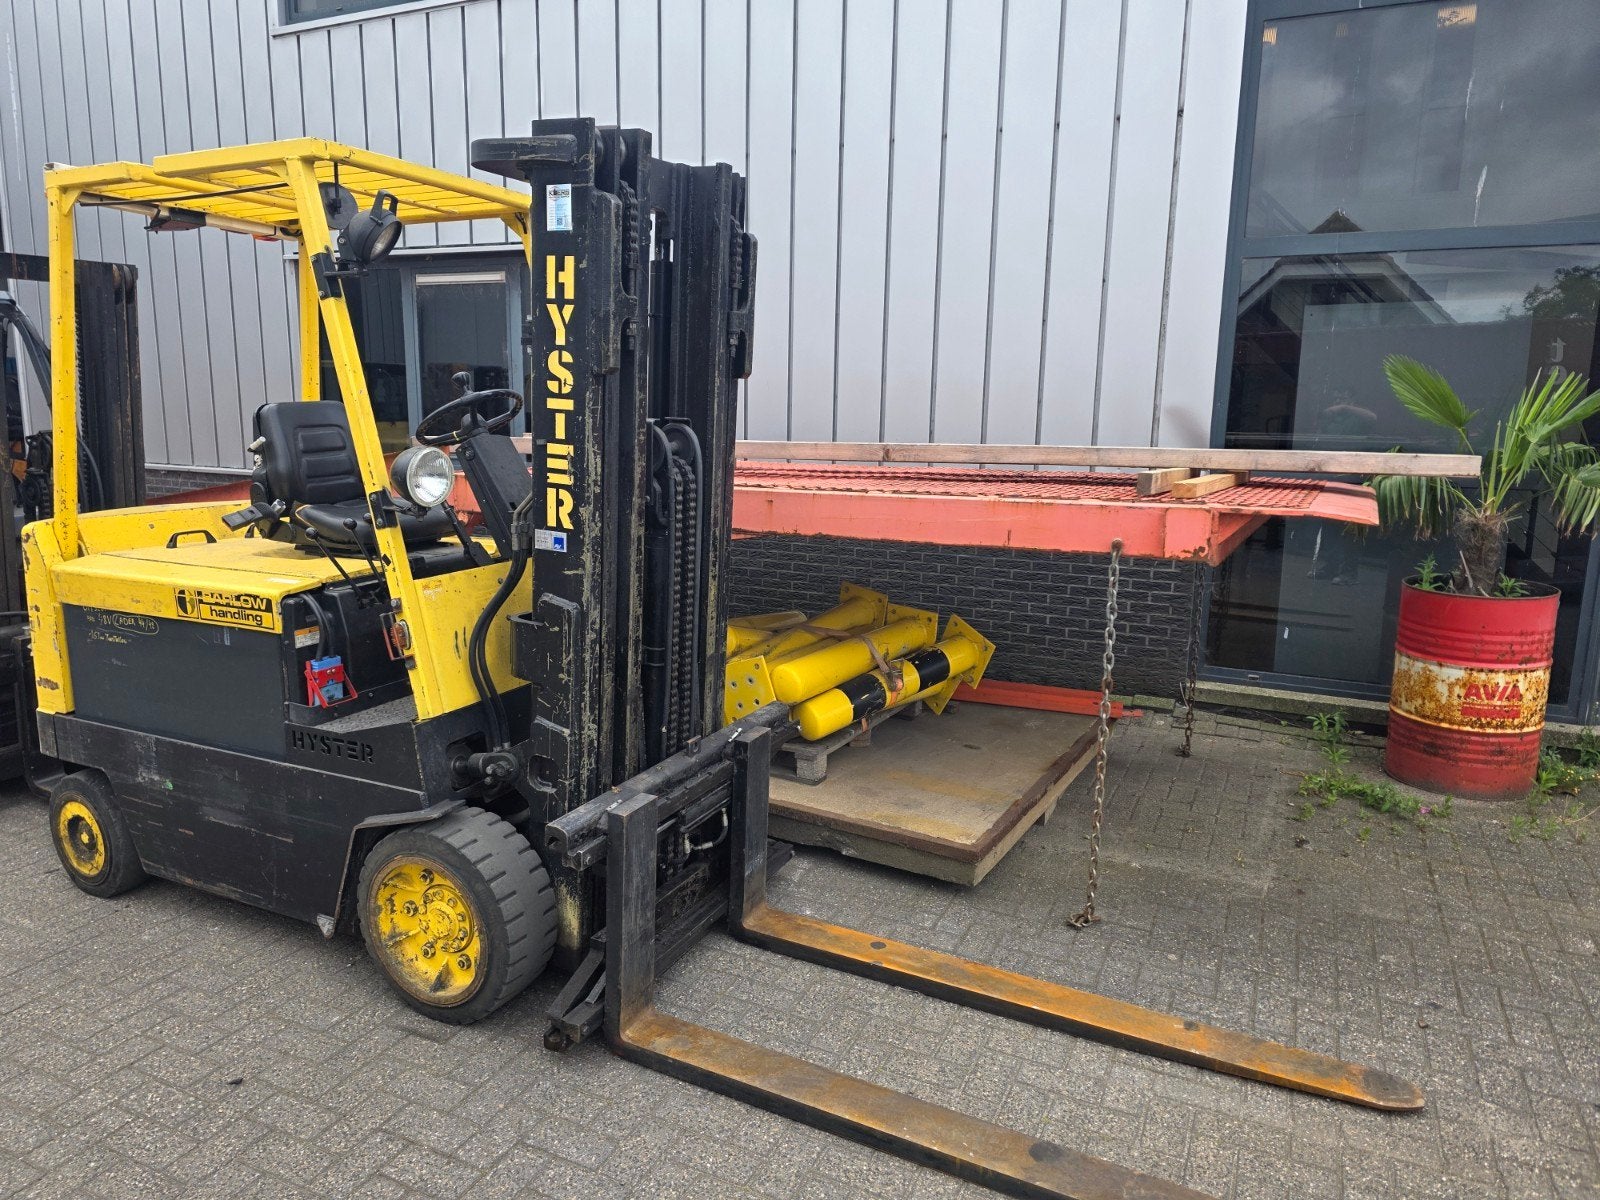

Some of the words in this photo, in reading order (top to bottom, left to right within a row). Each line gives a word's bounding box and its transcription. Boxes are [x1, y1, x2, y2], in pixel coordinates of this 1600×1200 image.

[546, 254, 575, 530] HYSTER
[209, 606, 263, 626] handling
[1463, 681, 1523, 702] AVIA
[291, 730, 375, 764] HYSTER
